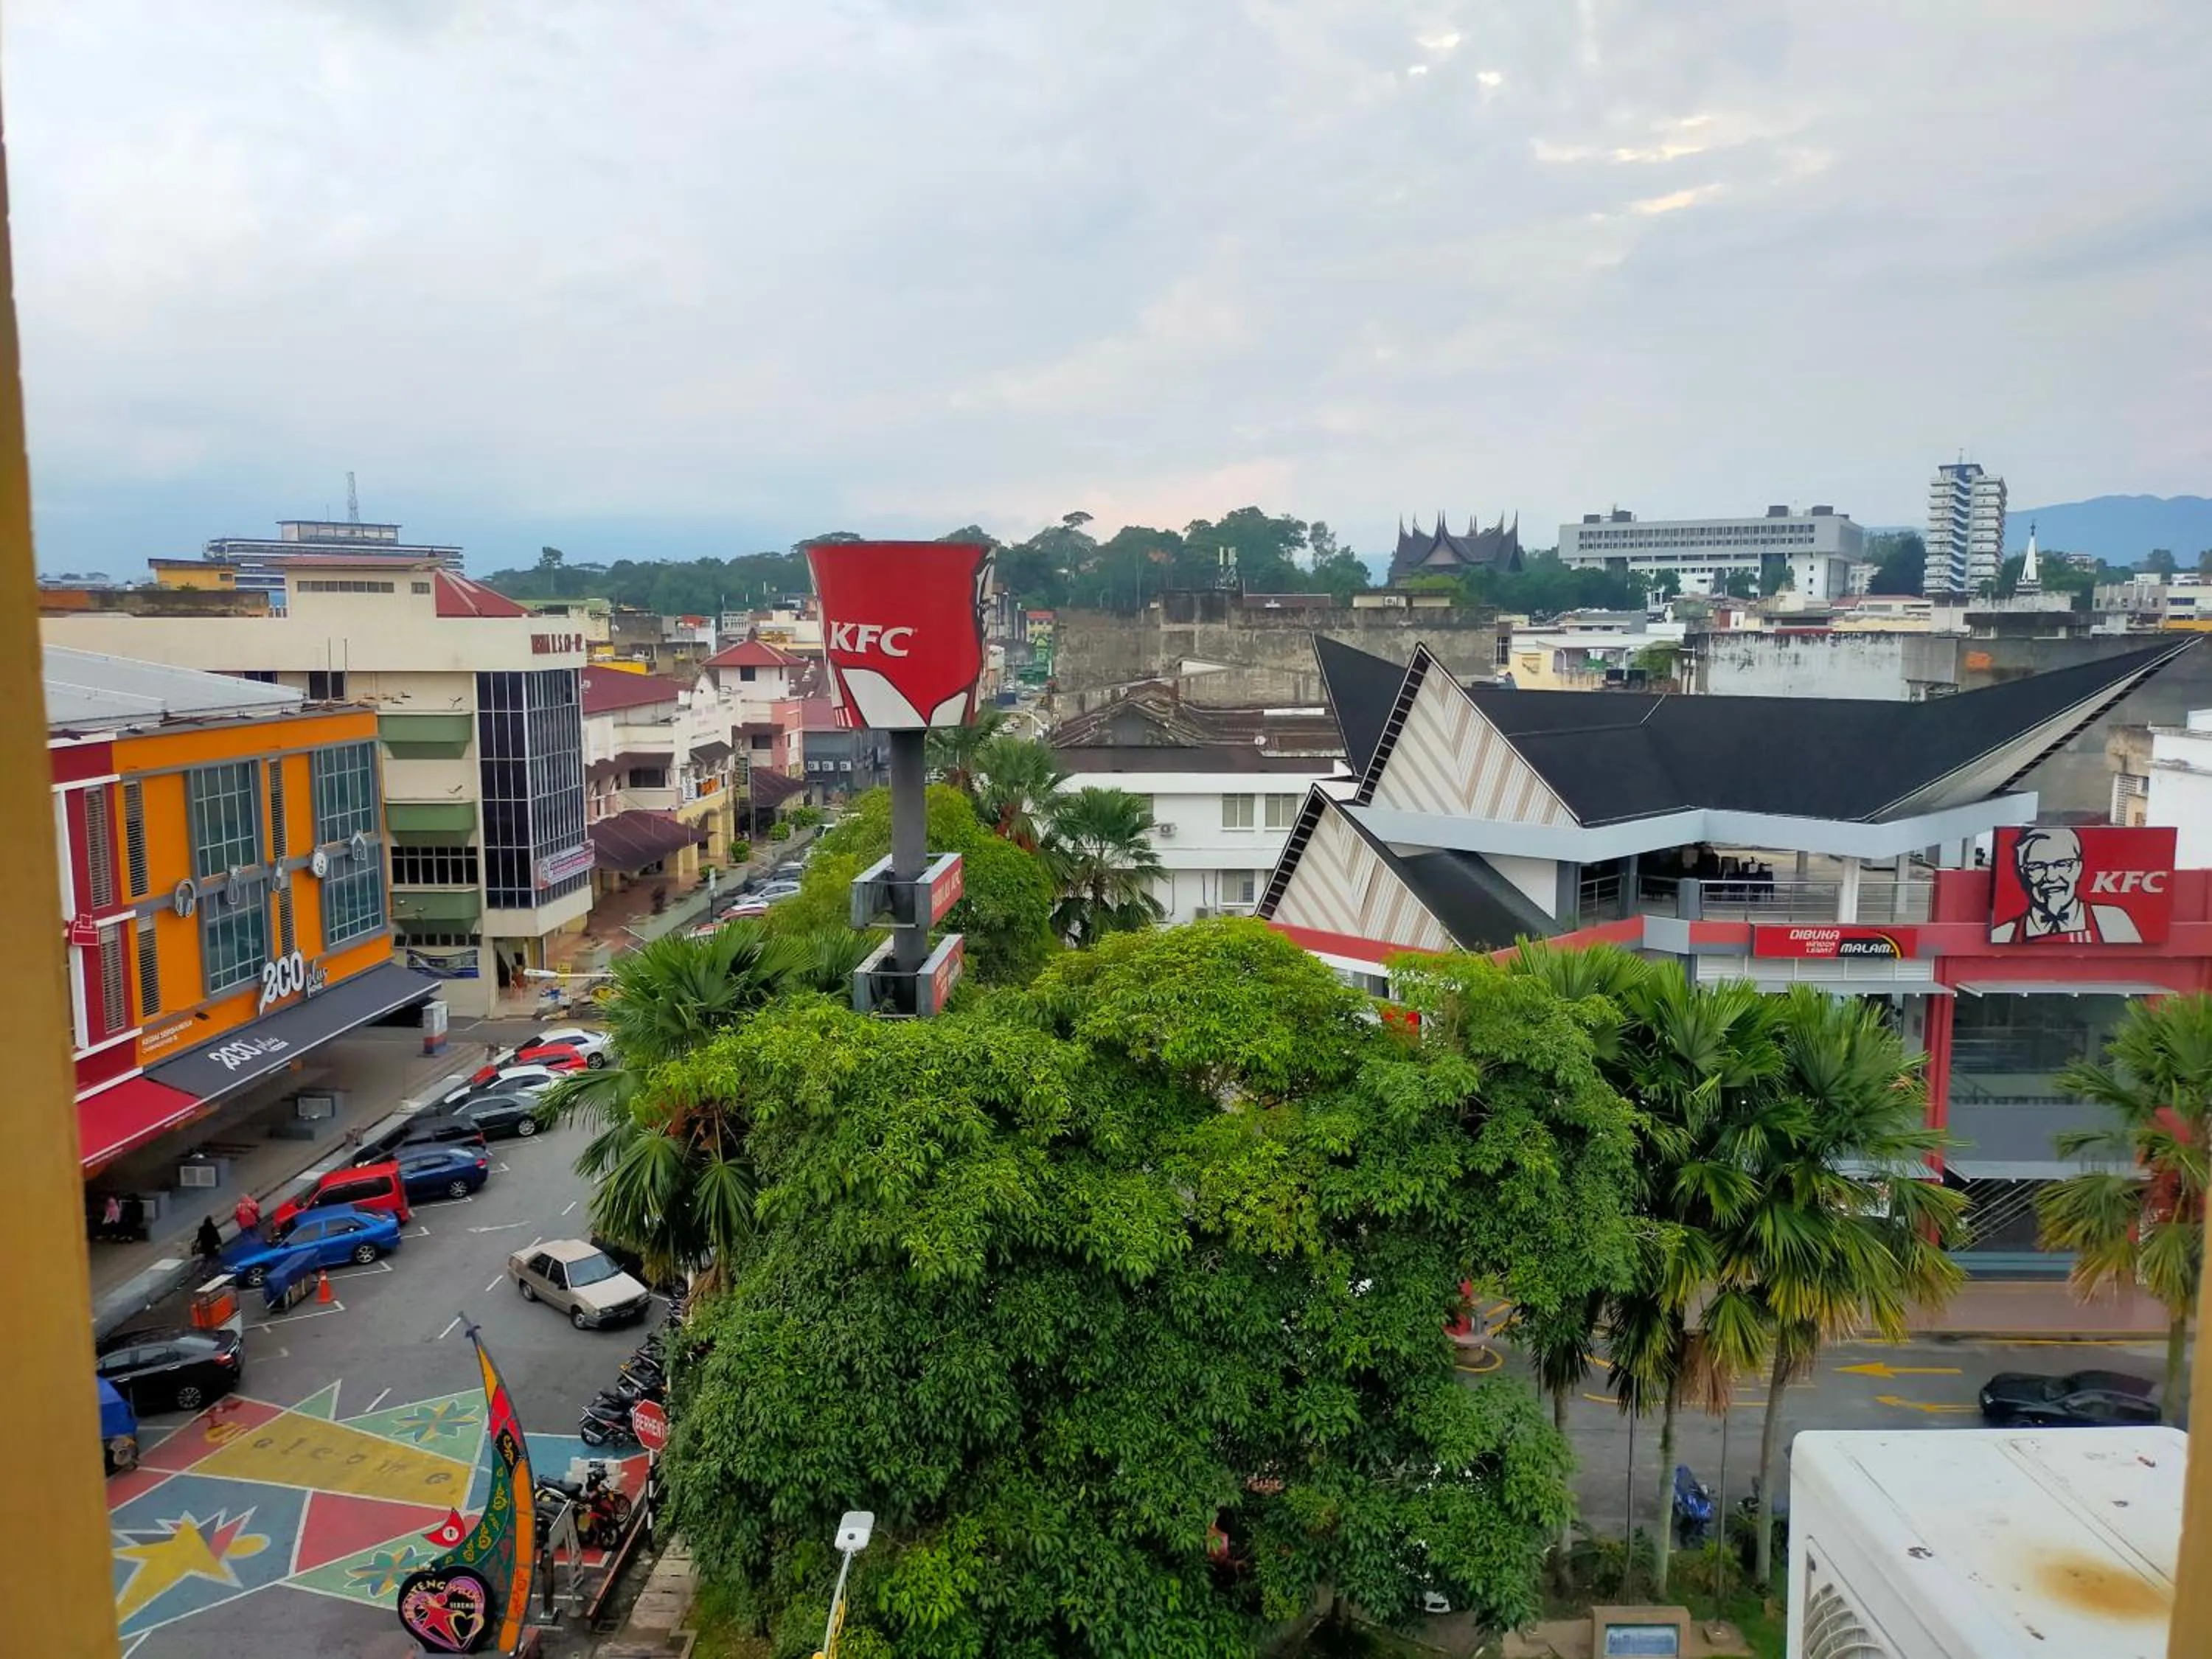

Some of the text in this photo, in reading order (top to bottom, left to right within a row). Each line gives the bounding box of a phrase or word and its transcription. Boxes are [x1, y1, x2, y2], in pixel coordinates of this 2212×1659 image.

[830, 621, 914, 657] KFC
[2089, 871, 2168, 893] KFC
[1790, 929, 1840, 940] DIBUKA
